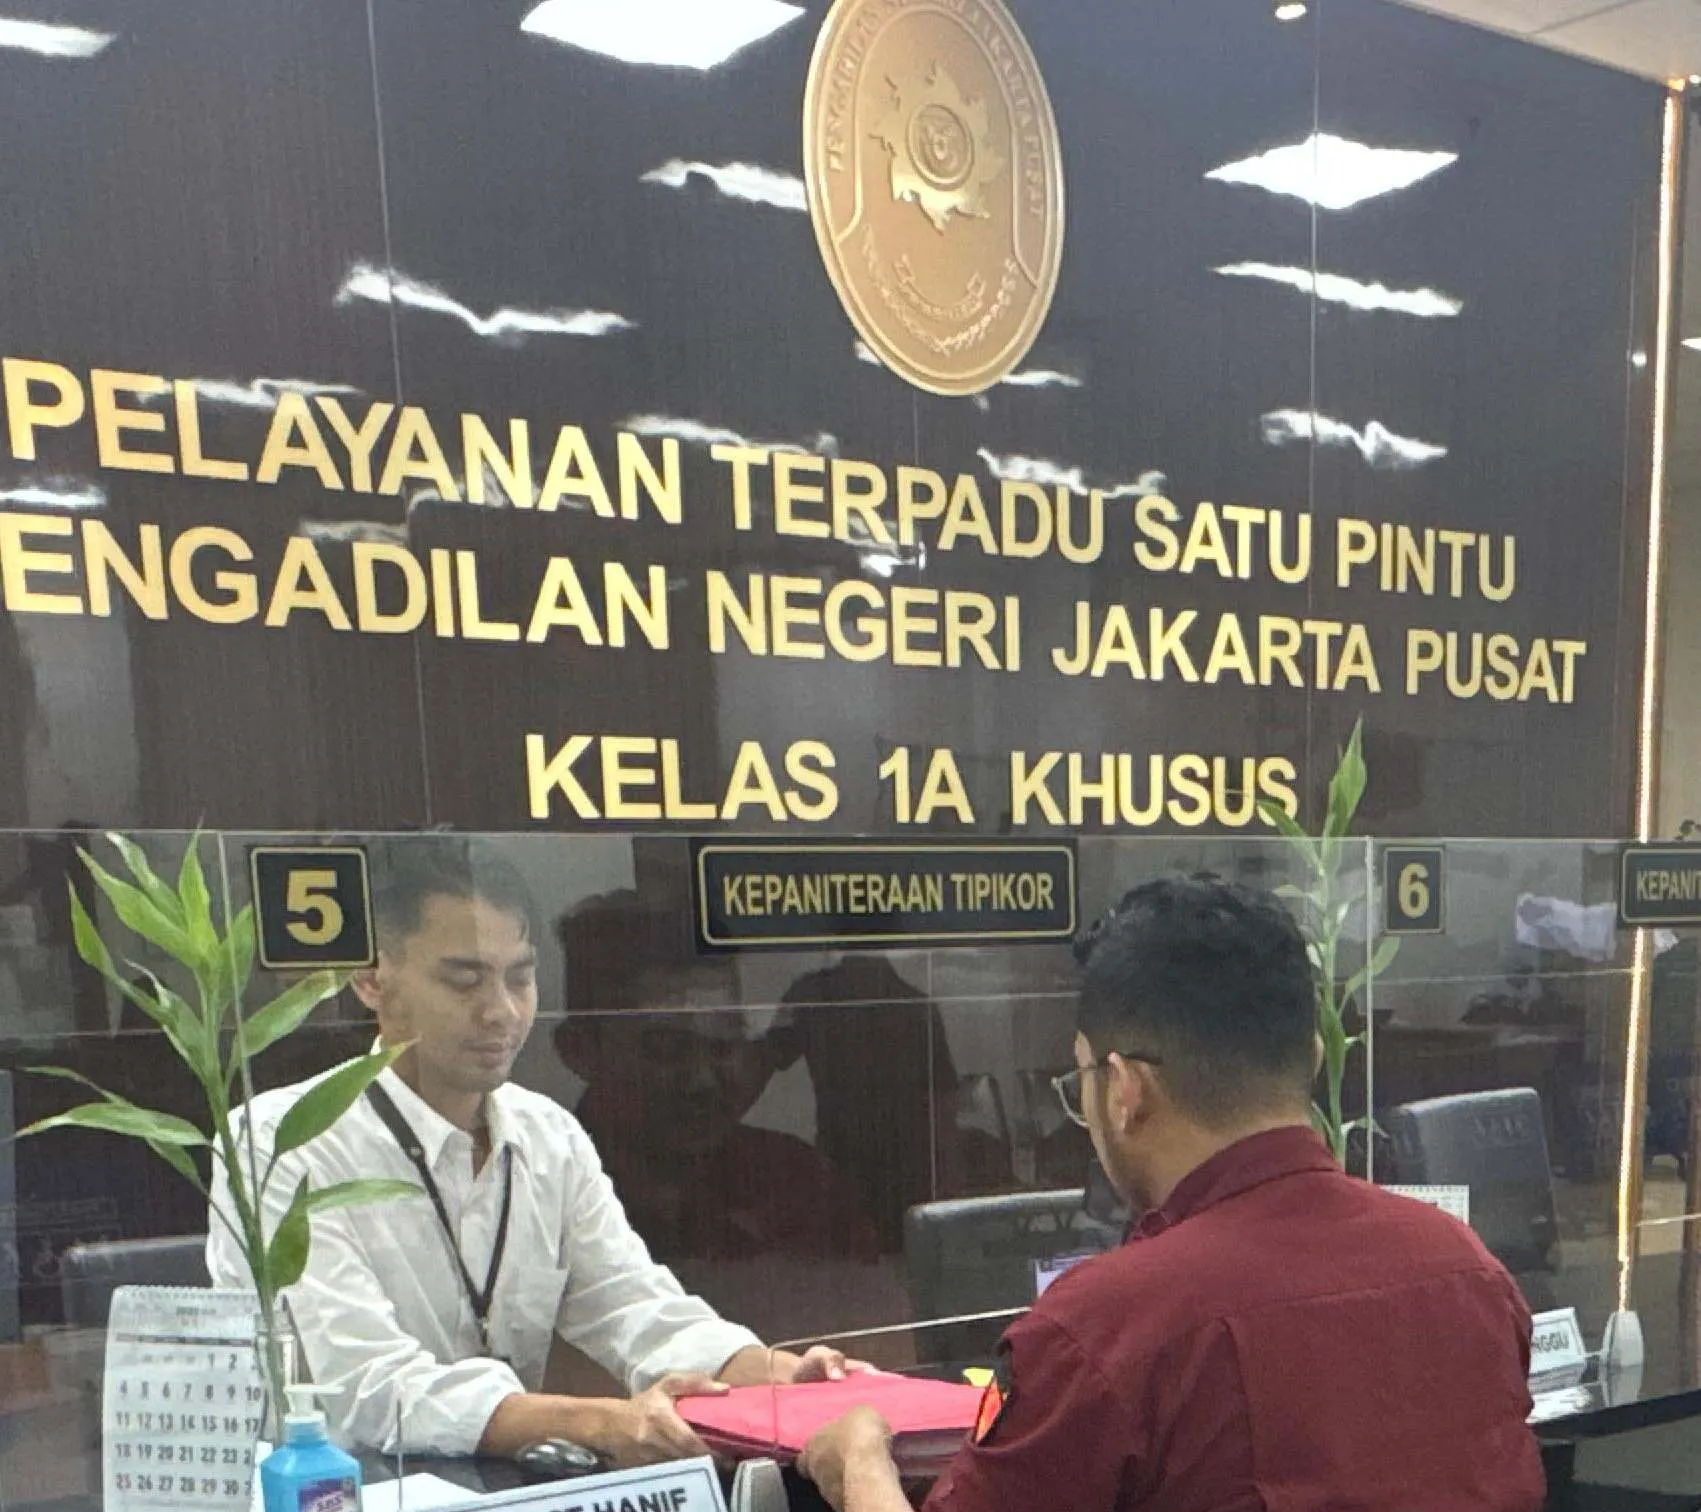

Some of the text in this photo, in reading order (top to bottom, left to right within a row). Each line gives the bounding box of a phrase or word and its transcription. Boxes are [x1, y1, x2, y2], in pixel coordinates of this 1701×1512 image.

[2, 357, 1516, 602] PELAYANAN TERPADU SATU PINTU
[708, 570, 1021, 672] NEGERI
[1052, 601, 1381, 694] JAKARTA
[1406, 628, 1587, 704] PUSAT
[525, 733, 1299, 828] KELAS 1A KHUSUS
[285, 870, 345, 946] 5
[722, 872, 1055, 917] KEPANITERAAN TIPIKOR
[1398, 862, 1431, 920] 6
